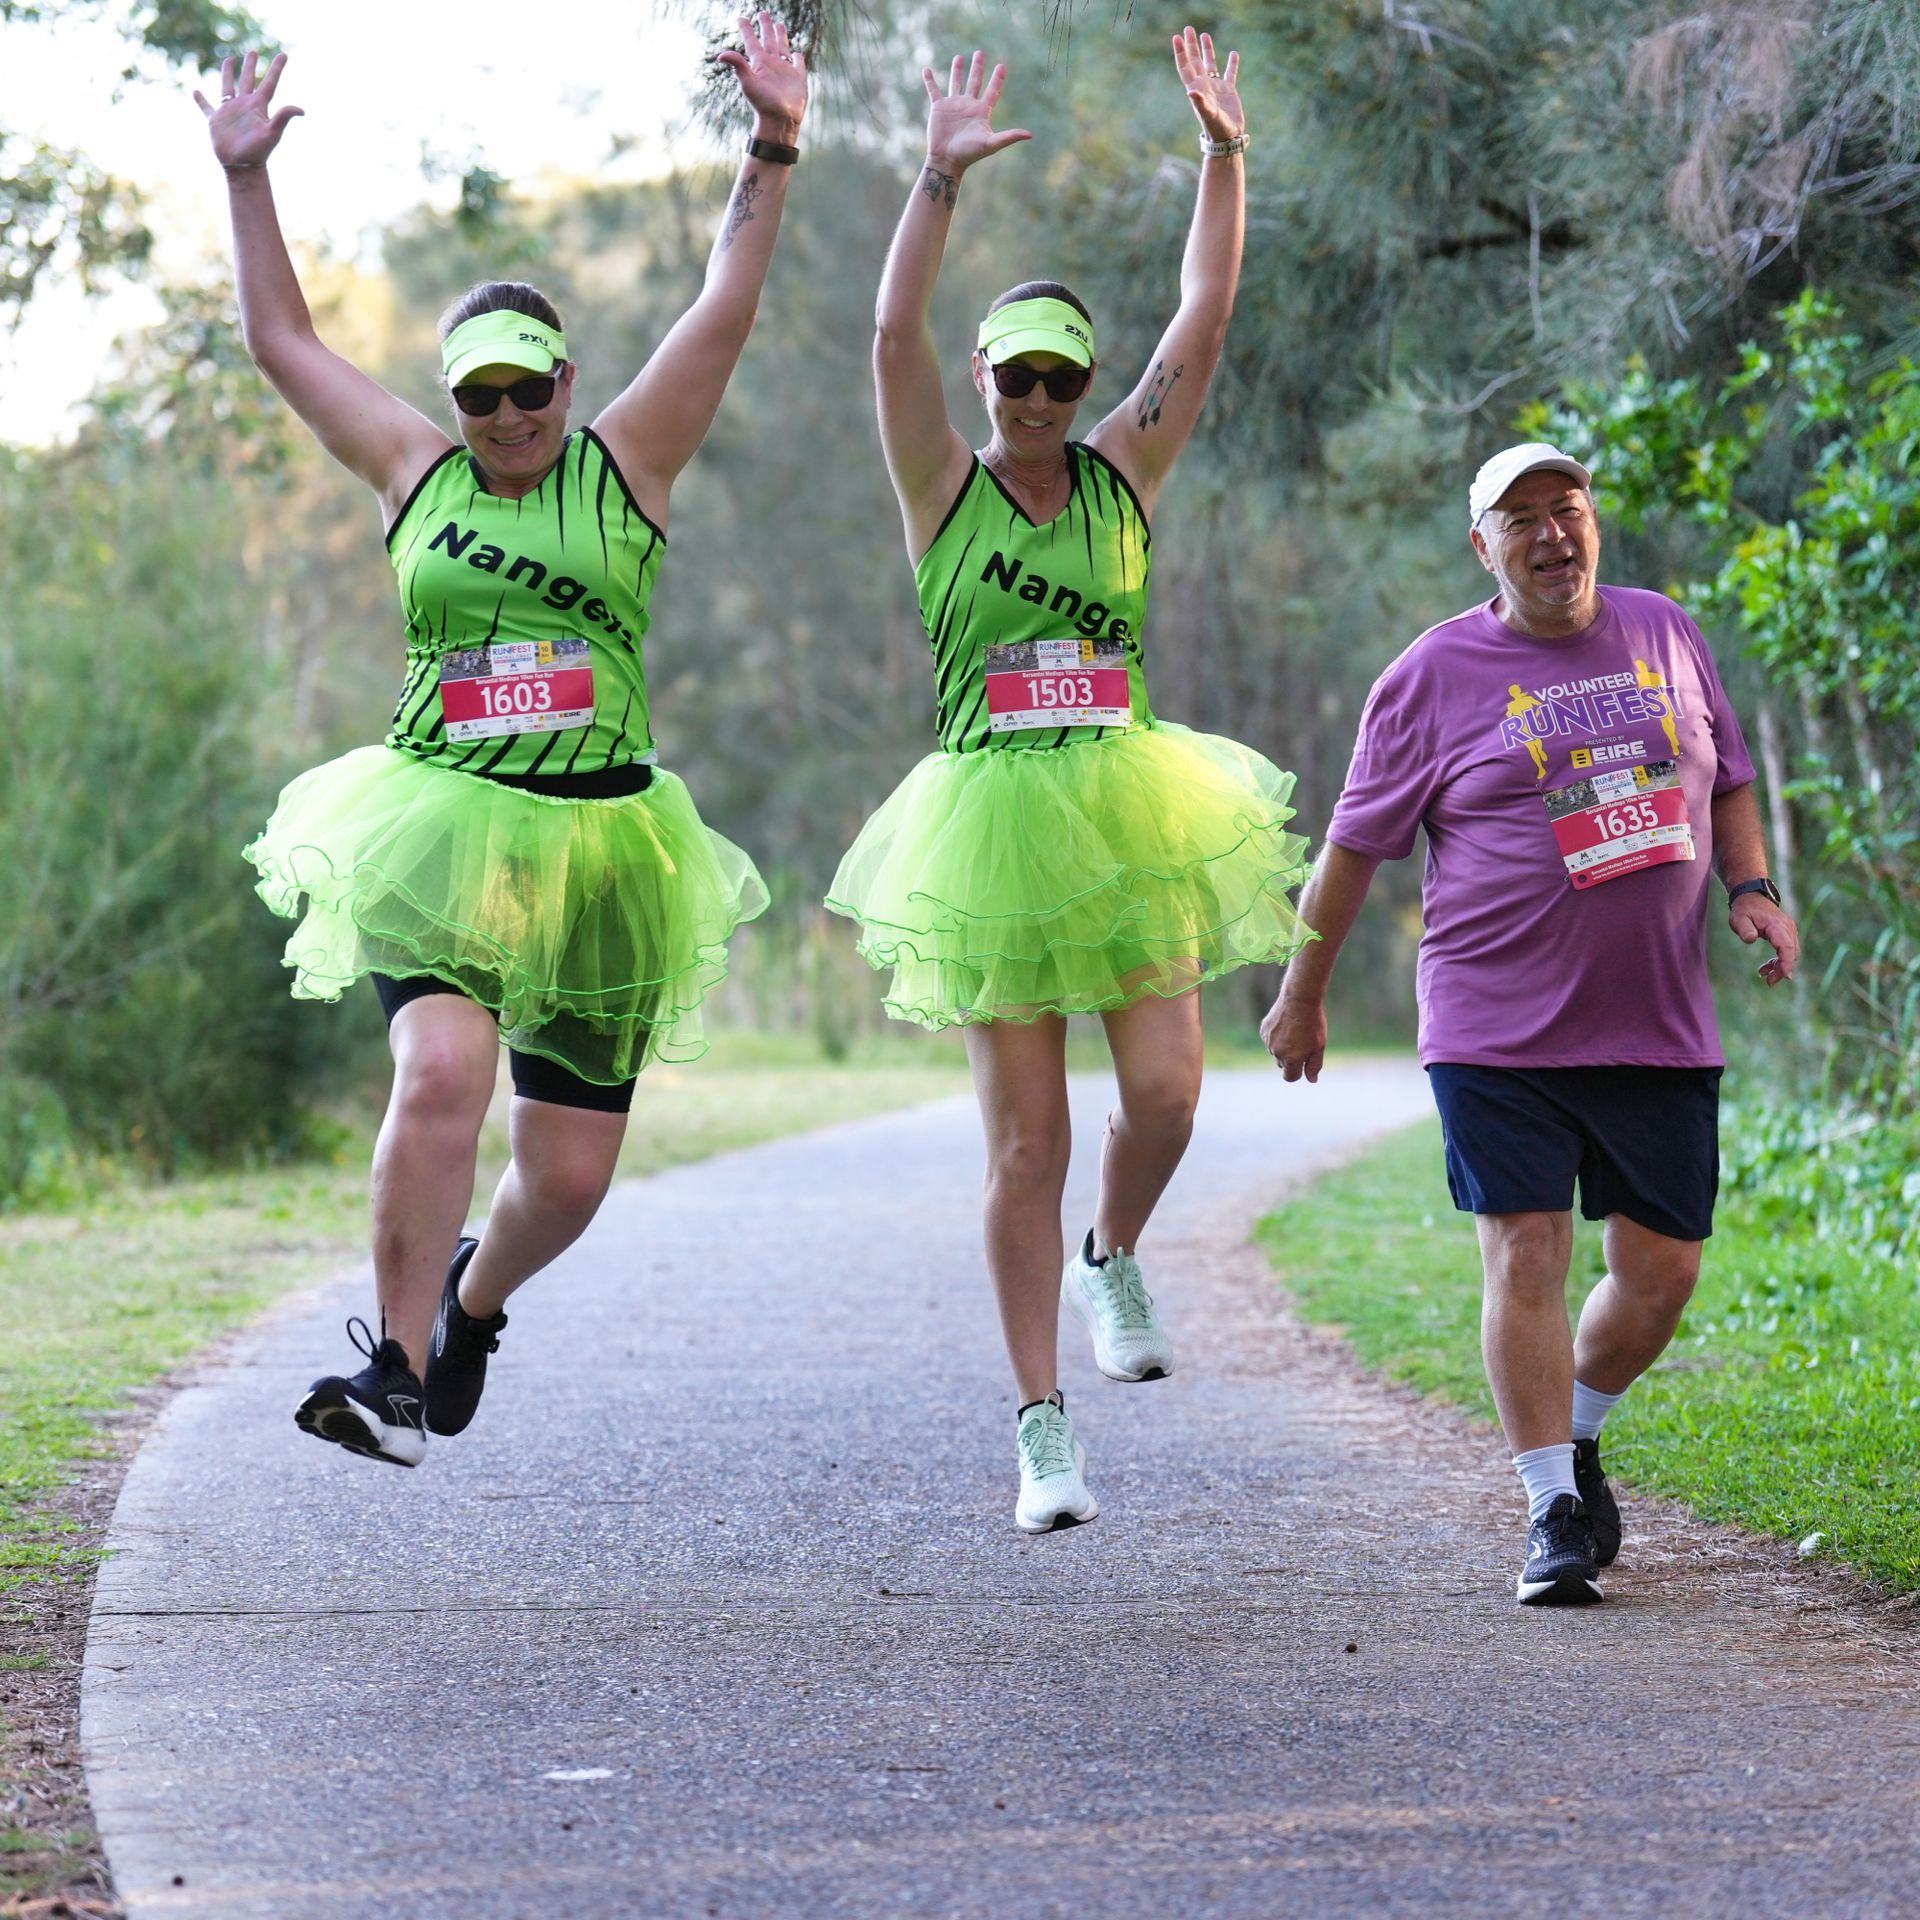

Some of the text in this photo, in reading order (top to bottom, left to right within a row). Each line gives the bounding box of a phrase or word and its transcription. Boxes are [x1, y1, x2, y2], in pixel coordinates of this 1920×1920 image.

[519, 333, 548, 347] 2XU
[1065, 324, 1088, 343] 2XU
[480, 681, 552, 715] 1603
[1027, 677, 1094, 707] 1503
[1534, 672, 1637, 702] VOLUNTEER
[1585, 736, 1617, 746] PRESENTED
[1591, 740, 1646, 761] EIRE
[1593, 801, 1659, 840] 1635
